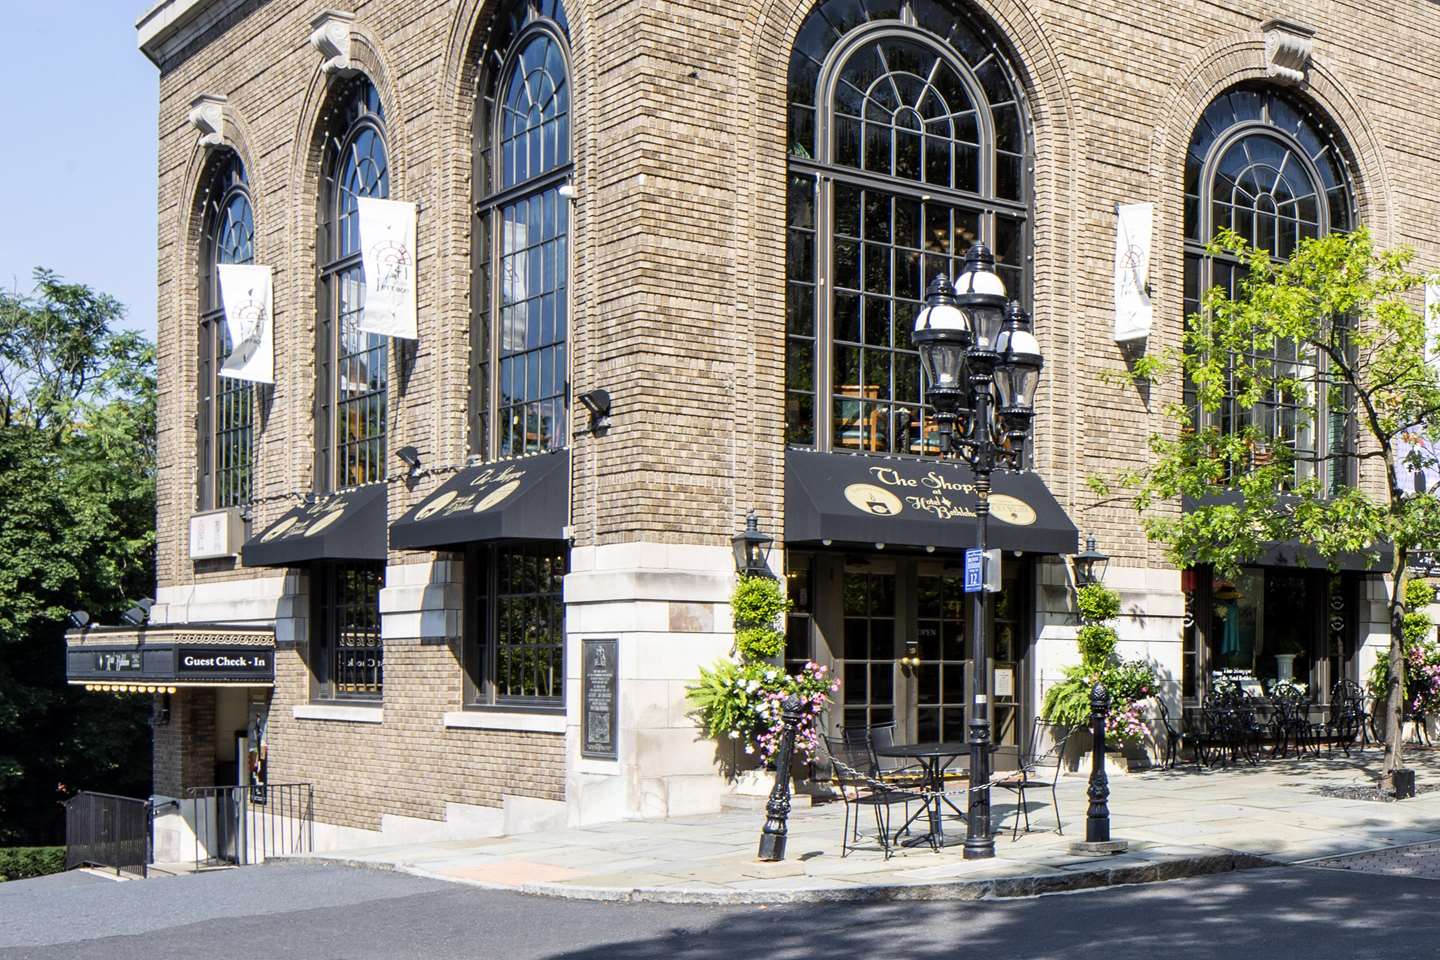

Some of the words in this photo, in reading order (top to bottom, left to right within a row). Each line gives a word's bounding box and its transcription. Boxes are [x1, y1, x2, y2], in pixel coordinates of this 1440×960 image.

[869, 466, 918, 487] The
[920, 471, 992, 495] Shop
[905, 496, 941, 511] Hotel
[969, 573, 978, 584] 12
[184, 656, 214, 666] Guest
[216, 656, 246, 667] Check
[254, 657, 265, 666] In
